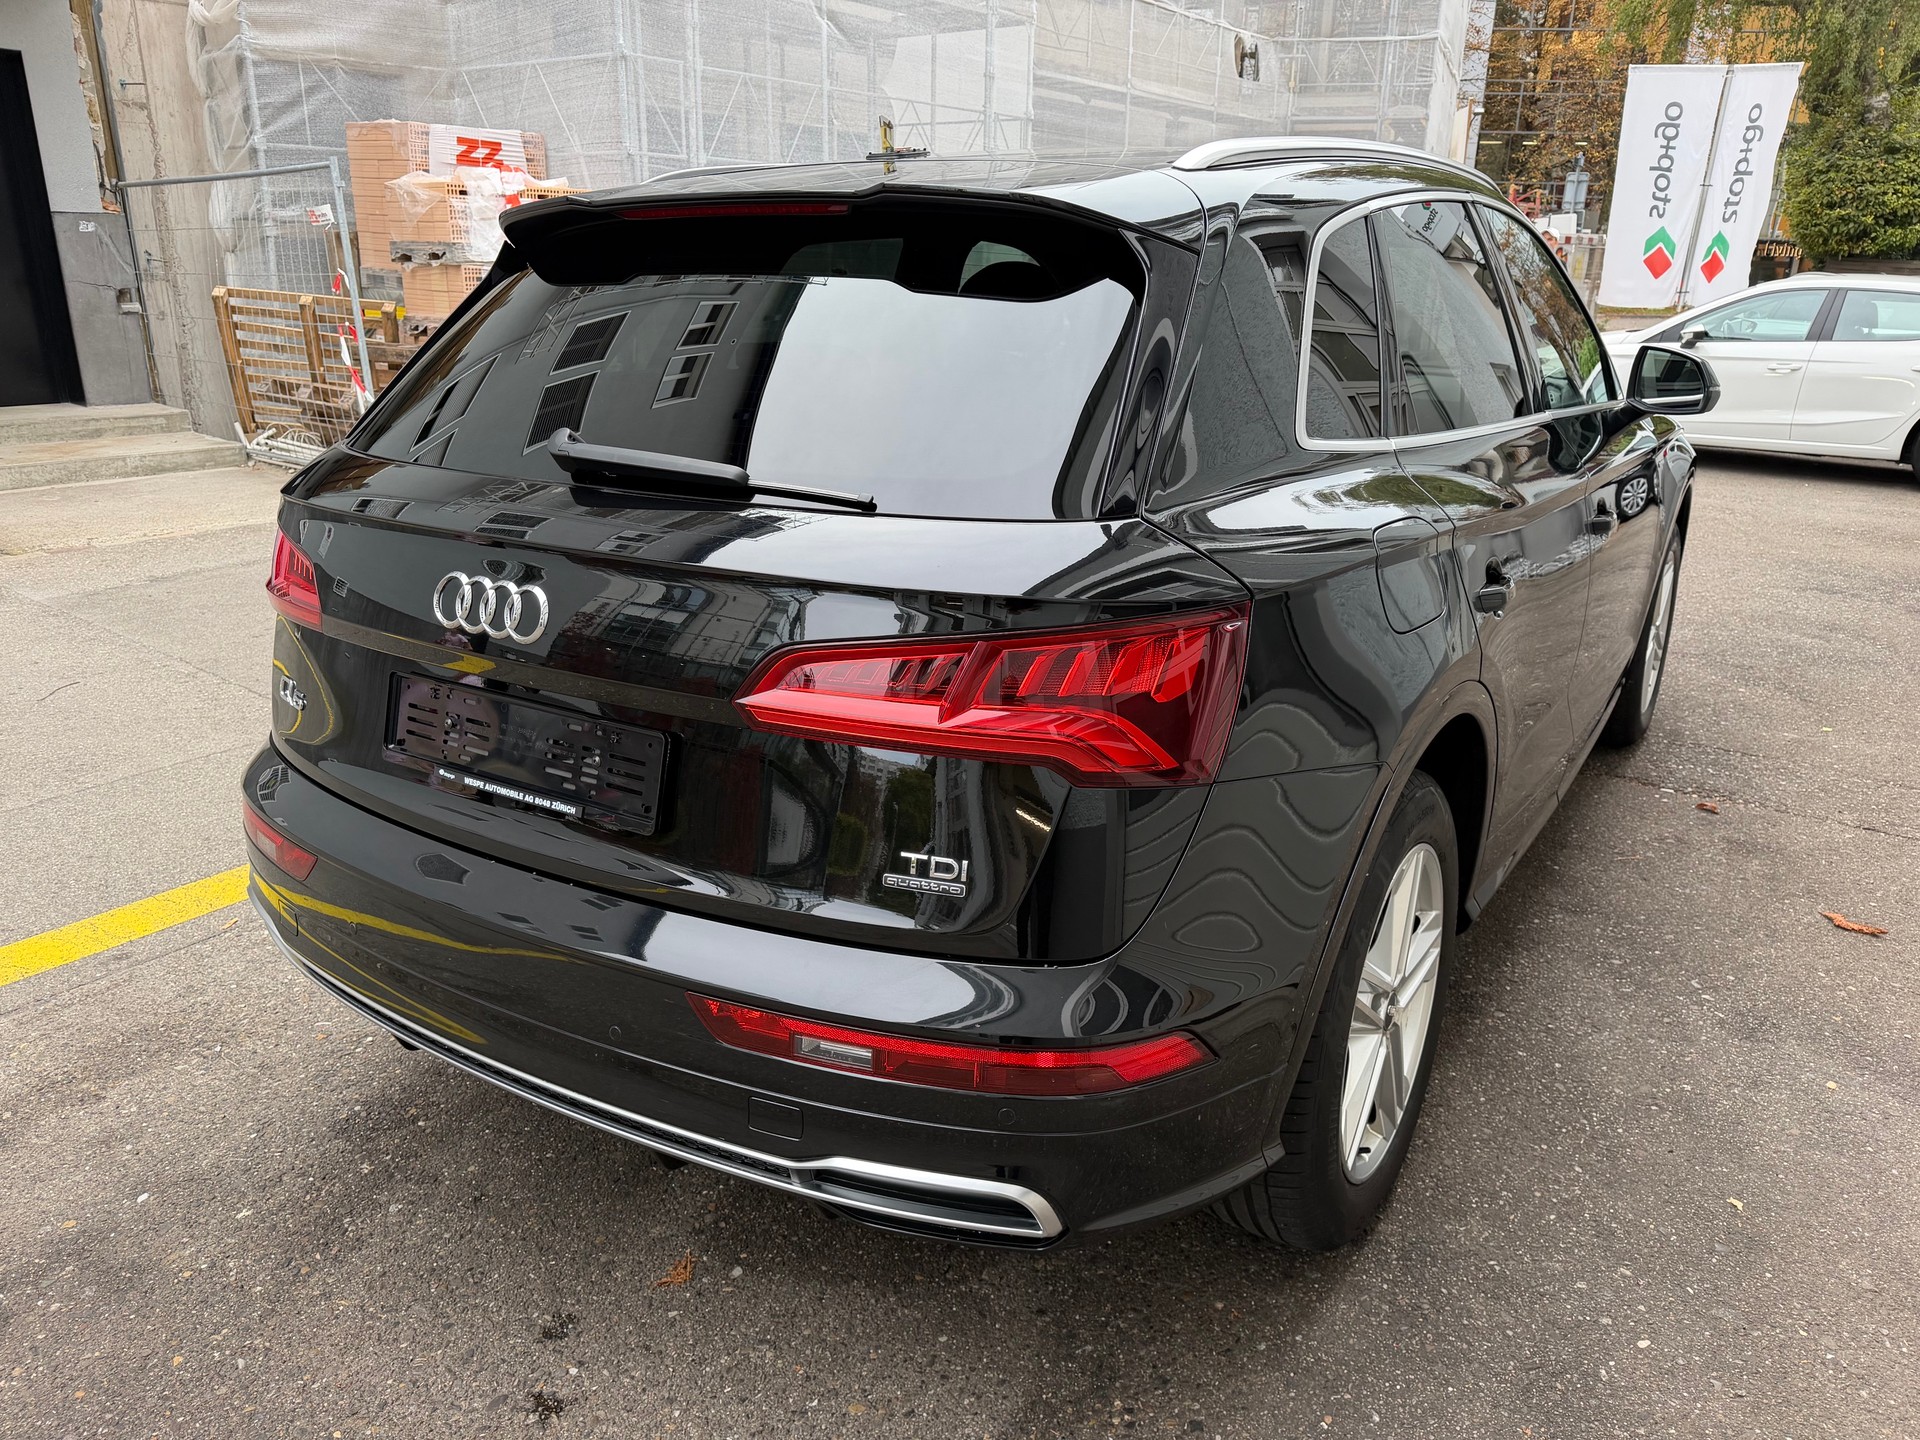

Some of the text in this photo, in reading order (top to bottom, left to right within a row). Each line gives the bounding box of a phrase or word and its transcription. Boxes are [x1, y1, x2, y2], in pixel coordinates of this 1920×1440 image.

[1721, 103, 1764, 224] stop+go
[280, 675, 308, 711] Q5
[464, 777, 576, 814] WESPE AUTOMOBILE AG 8048 ZÜRICH
[900, 851, 968, 882] TDI
[885, 877, 961, 894] quattro
